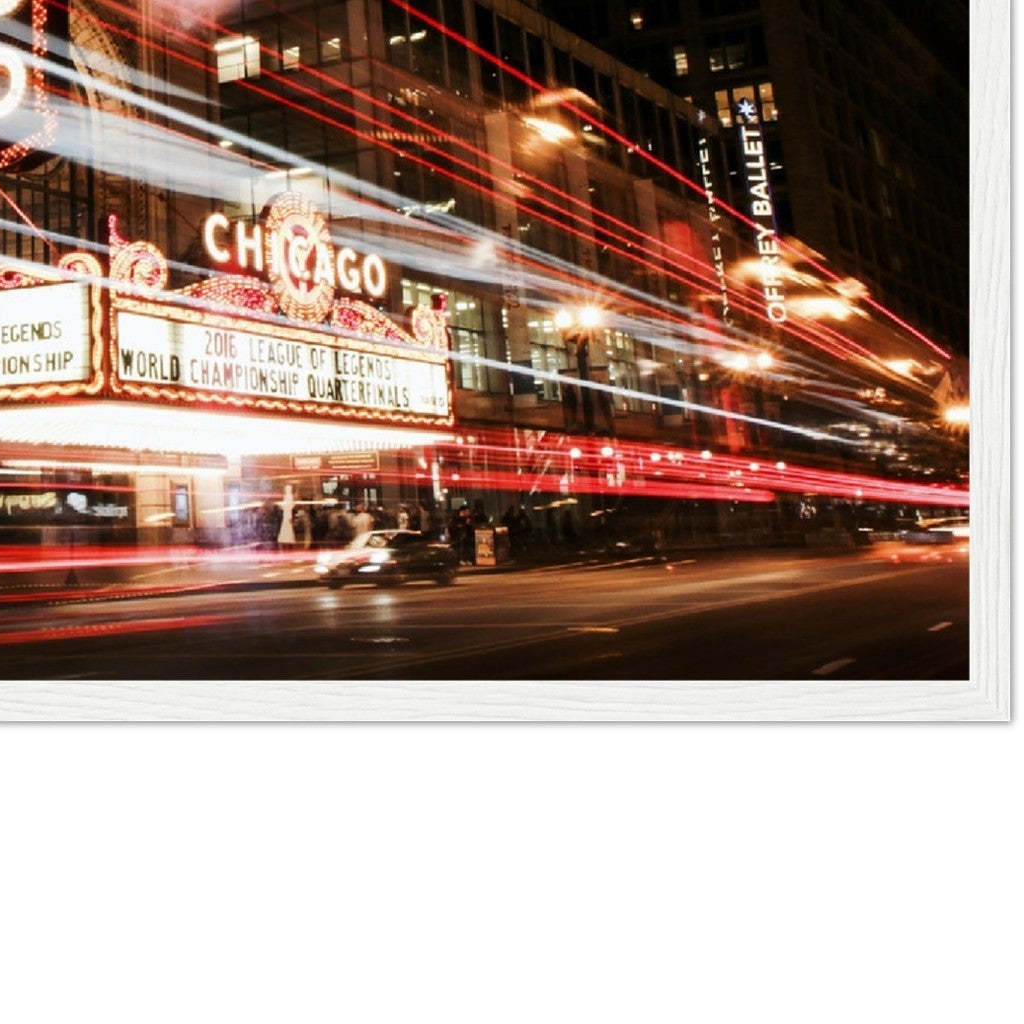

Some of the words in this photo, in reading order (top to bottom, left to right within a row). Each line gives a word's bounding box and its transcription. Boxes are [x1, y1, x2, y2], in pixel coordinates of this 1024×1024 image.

[741, 125, 773, 217] BALLET
[204, 212, 387, 297] CHICAGO
[120, 347, 181, 382] WORLD
[189, 358, 300, 396] CHAMPIONSHIP
[307, 373, 410, 409] QUARTERFINALS
[205, 330, 237, 359] 2016
[249, 337, 303, 369] LEAGUE
[310, 347, 326, 370] OF
[334, 350, 392, 381] LEGENDS
